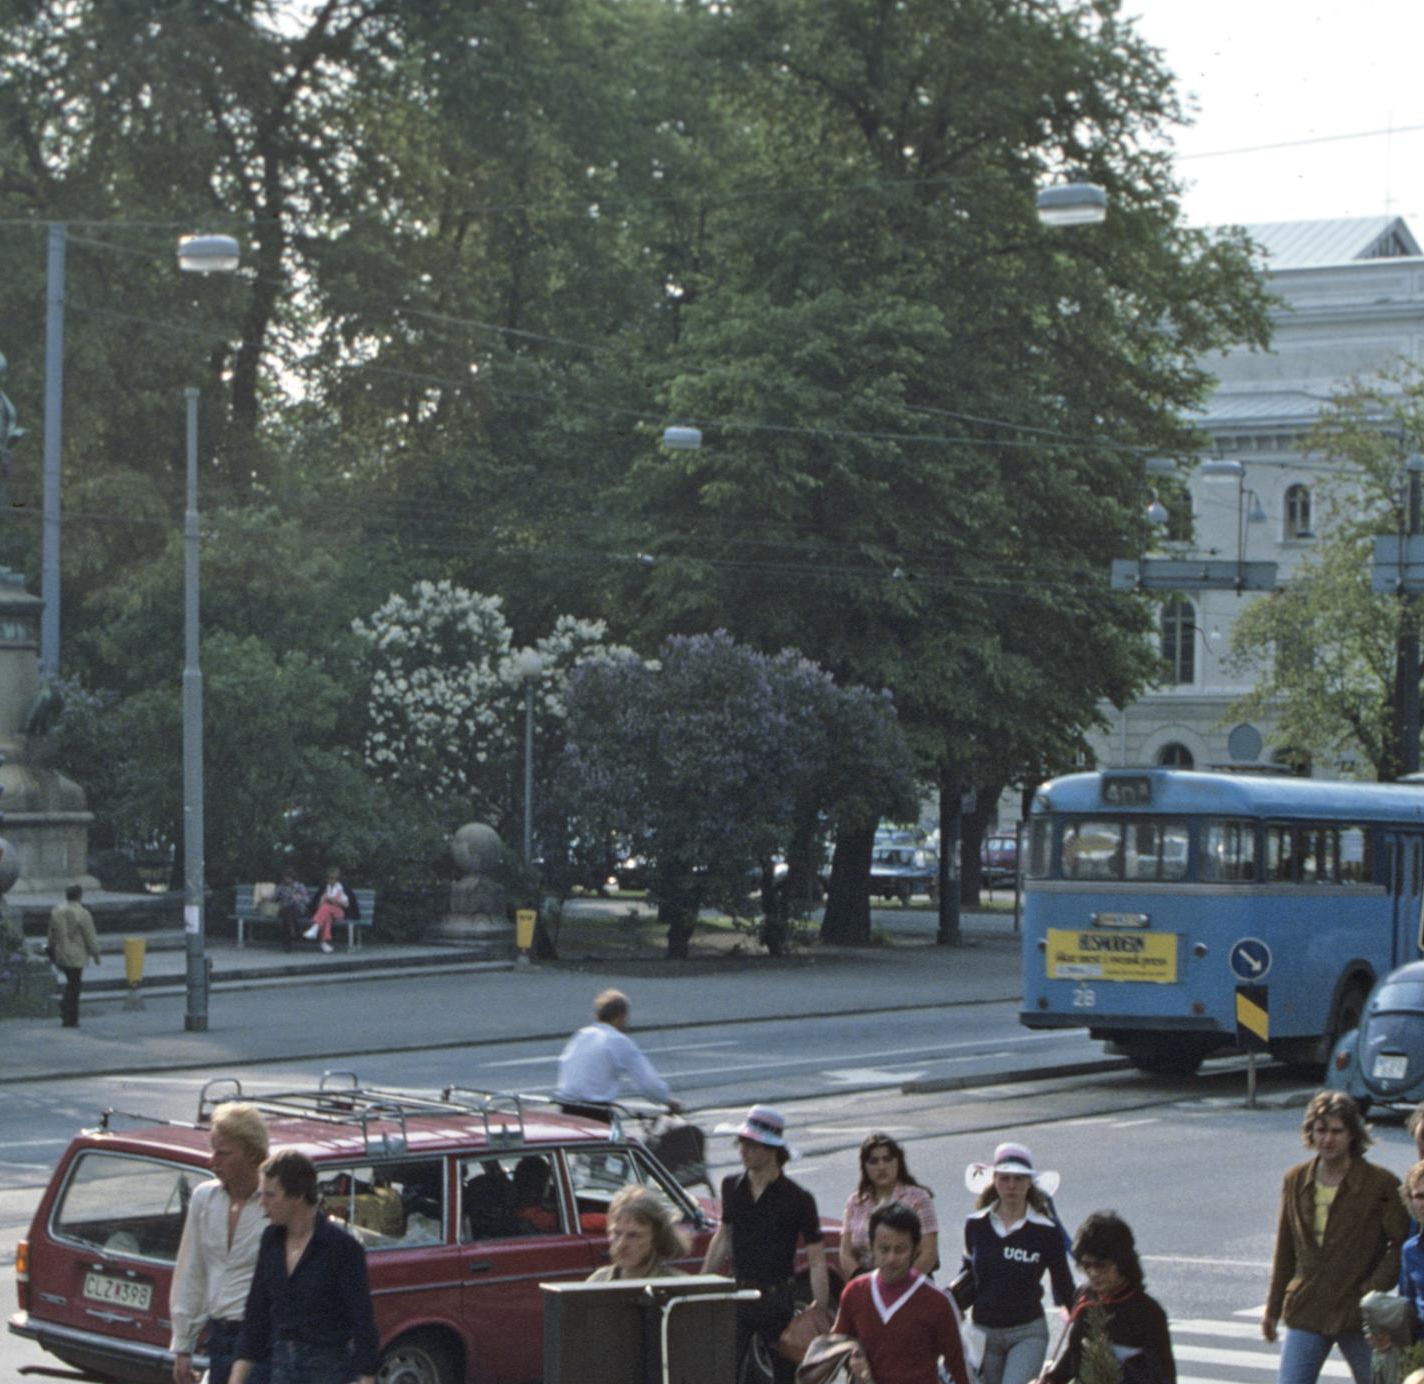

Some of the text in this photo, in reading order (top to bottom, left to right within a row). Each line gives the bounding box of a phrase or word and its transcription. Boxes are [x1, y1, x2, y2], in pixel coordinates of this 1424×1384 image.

[1072, 989, 1096, 1008] 28
[1003, 1246, 1041, 1263] UCLA
[86, 1275, 148, 1306] CLZ 398
